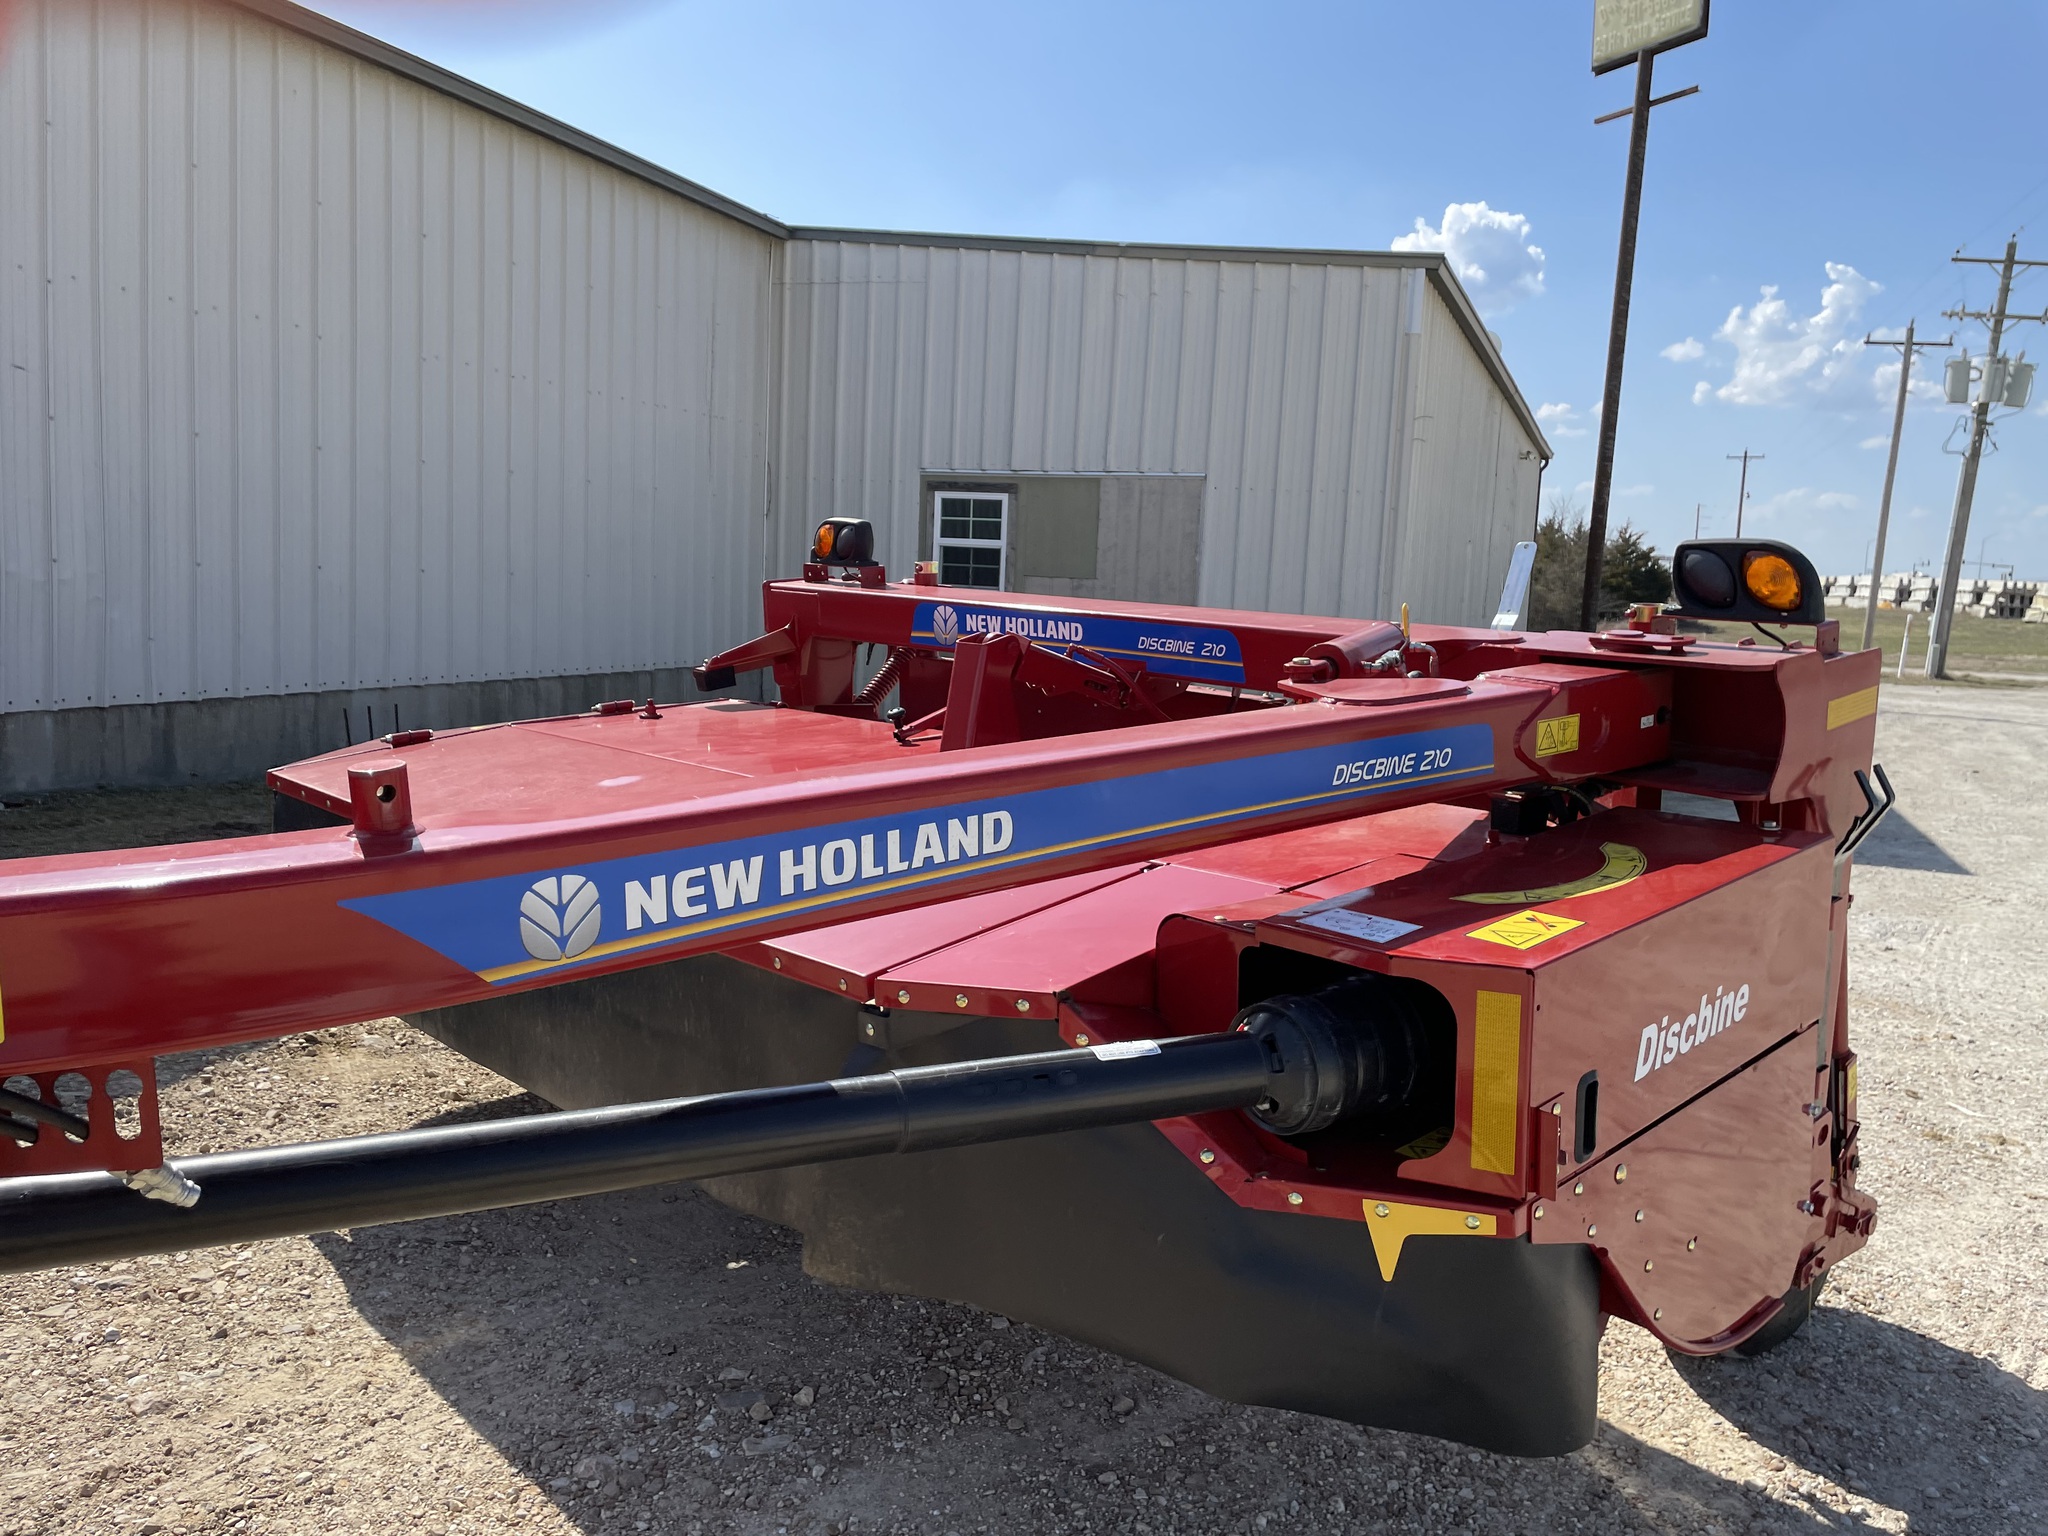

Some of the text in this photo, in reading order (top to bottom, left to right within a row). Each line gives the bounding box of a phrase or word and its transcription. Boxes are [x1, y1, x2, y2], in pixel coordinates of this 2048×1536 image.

[965, 614, 1084, 642] NEW HOLLAND
[1138, 636, 1226, 657] DISCBINE 210
[1332, 748, 1452, 786] DISCBINE 210
[624, 810, 1014, 931] NEW HOLLAND
[1634, 983, 1749, 1083] Discbine
